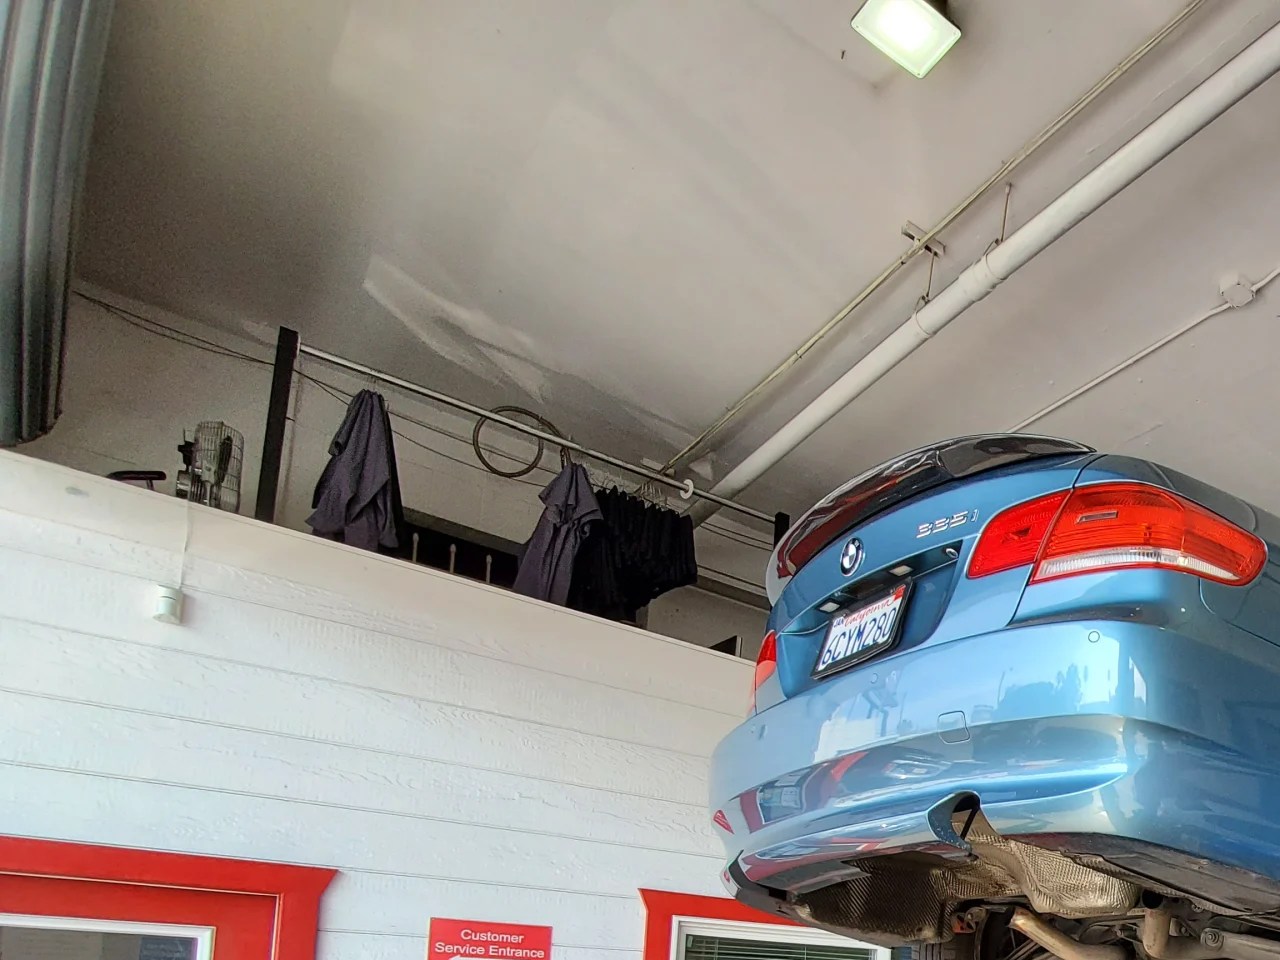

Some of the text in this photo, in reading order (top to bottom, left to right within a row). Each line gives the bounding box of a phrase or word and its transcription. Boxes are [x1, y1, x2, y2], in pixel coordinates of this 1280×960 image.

[915, 508, 980, 538] 335i
[821, 606, 897, 666] 6CYM280
[460, 929, 524, 943] Customer
[434, 942, 545, 959] Service Entrance
